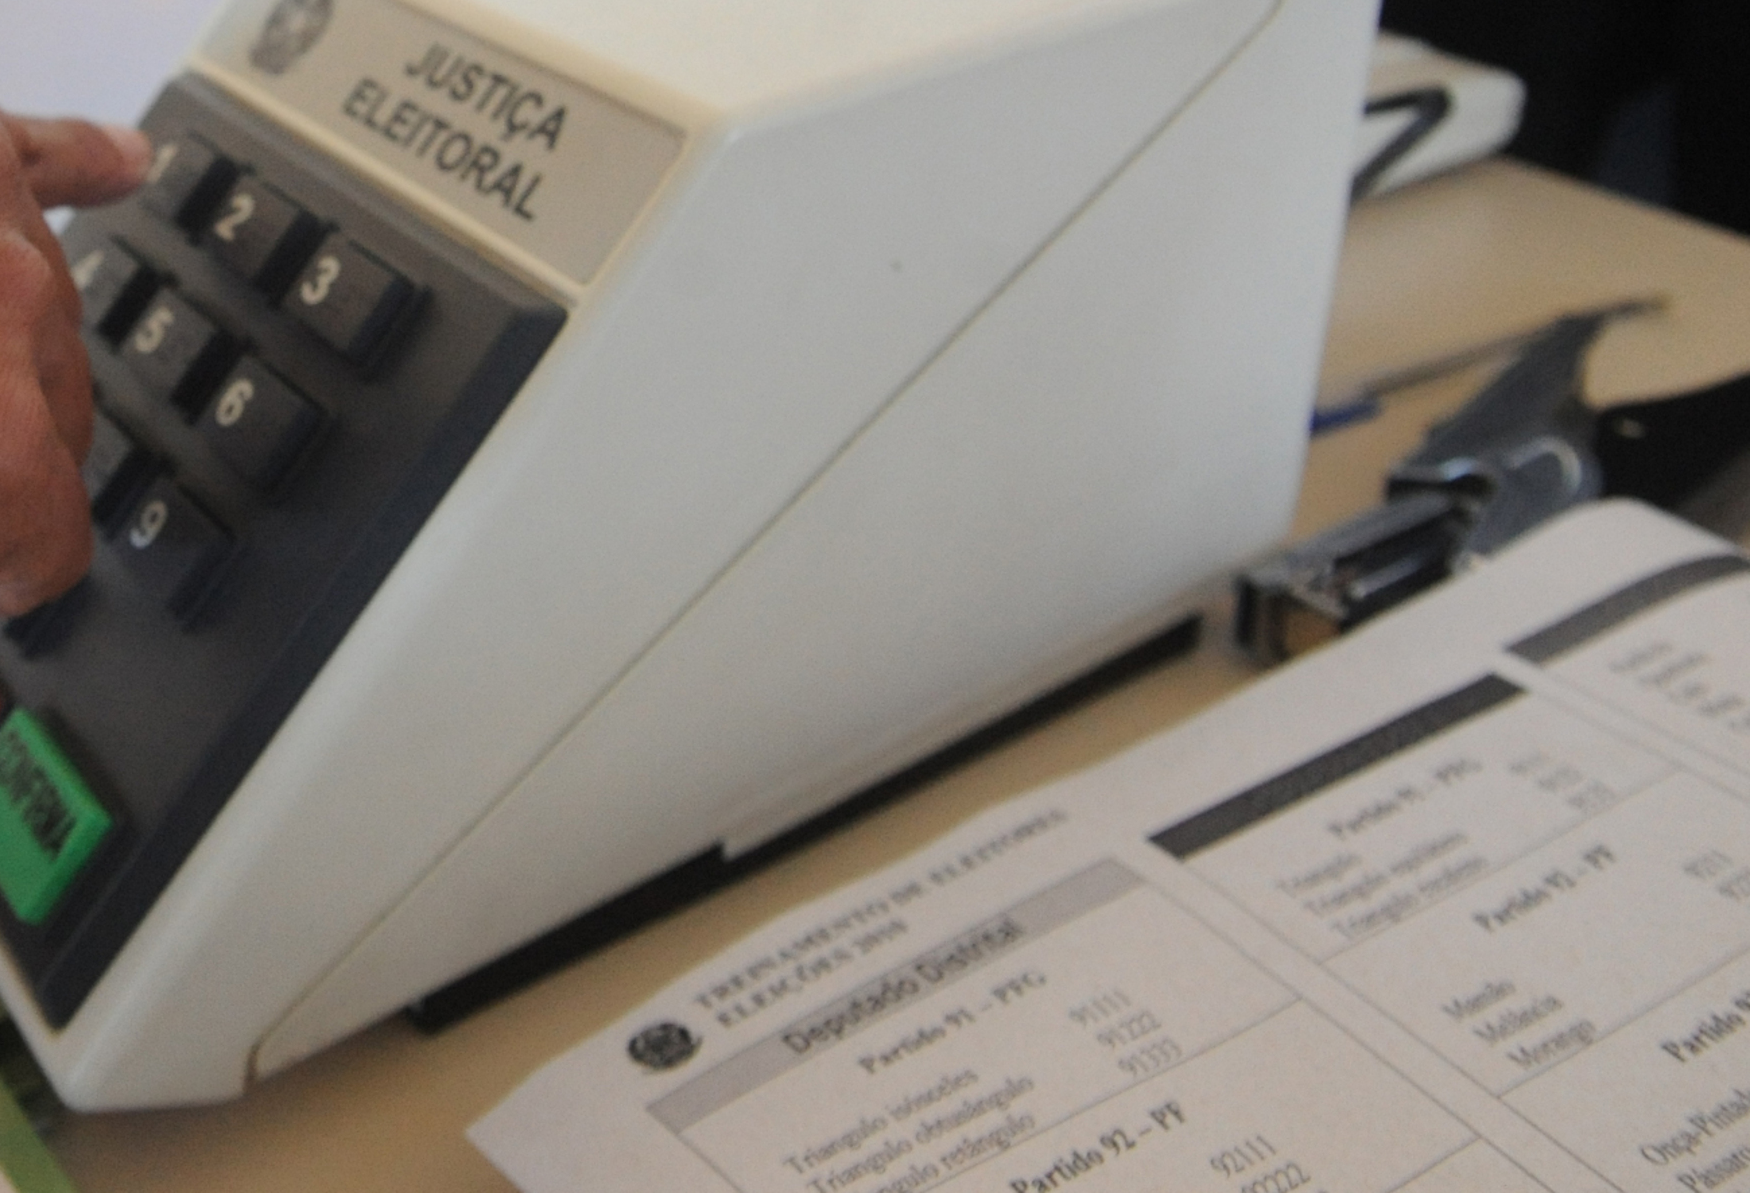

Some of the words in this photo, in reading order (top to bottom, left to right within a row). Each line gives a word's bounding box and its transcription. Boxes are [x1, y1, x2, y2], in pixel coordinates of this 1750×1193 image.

[405, 42, 567, 150] JUSTIÇA
[343, 78, 544, 222] ELEITORAL
[215, 193, 253, 241] 2
[301, 255, 340, 304] 3
[135, 307, 174, 353] 5
[215, 378, 253, 427] 6
[129, 500, 167, 549] 9
[782, 975, 921, 1054] Deputado
[914, 914, 1025, 984] Distrital
[858, 1023, 948, 1075] Partido
[1660, 1011, 1746, 1063] Partido
[1008, 1149, 1105, 1193] Partido
[1099, 1127, 1136, 1156] 92
[1209, 1135, 1277, 1178] 92111
